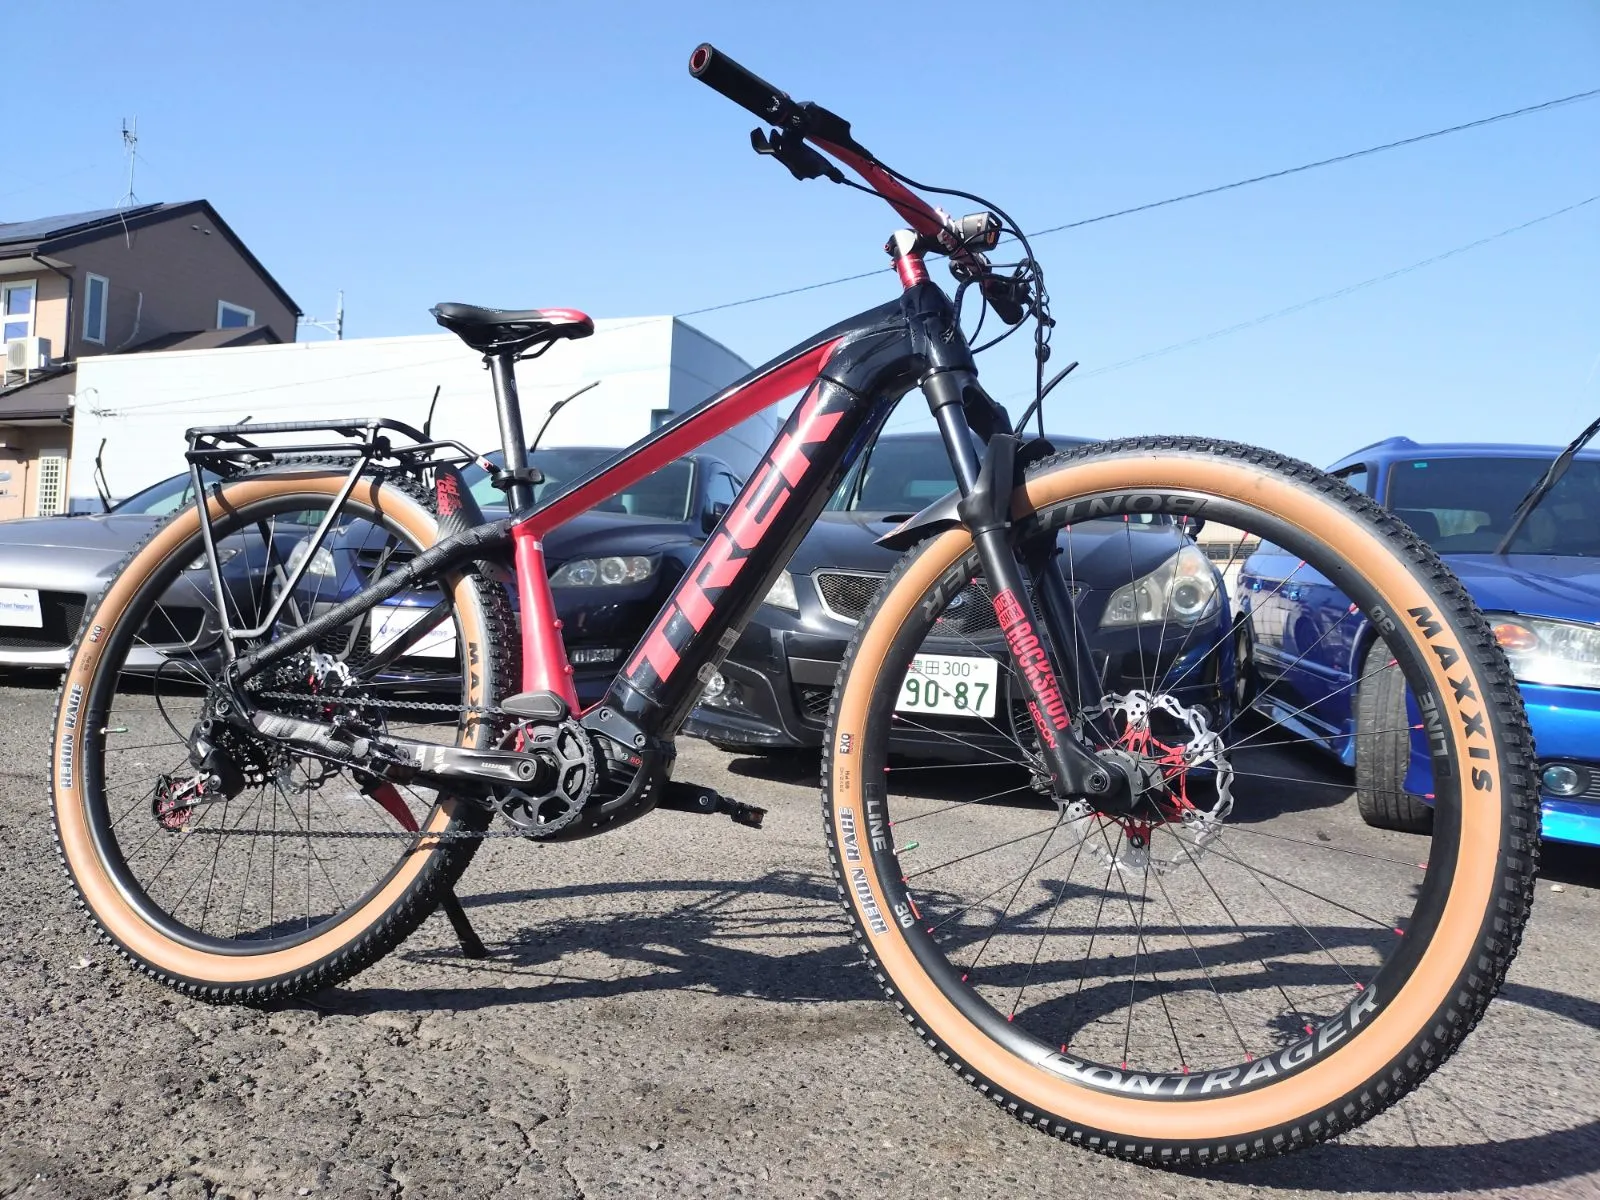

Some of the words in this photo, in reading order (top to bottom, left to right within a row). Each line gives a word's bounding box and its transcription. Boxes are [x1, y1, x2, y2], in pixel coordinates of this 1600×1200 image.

[626, 383, 844, 683] TREK
[1370, 606, 1396, 635] 30
[64, 683, 84, 730] RACE
[905, 678, 990, 711] 90-87
[1407, 606, 1493, 792] MAXXIS
[839, 733, 851, 754] EXO
[1418, 691, 1449, 756] LINE
[60, 734, 74, 789] REKON
[839, 806, 862, 863] RACE
[866, 800, 887, 851] LINE
[850, 867, 889, 936] REKON
[894, 902, 915, 929] 30
[1048, 983, 1380, 1096] BONTRAGER
